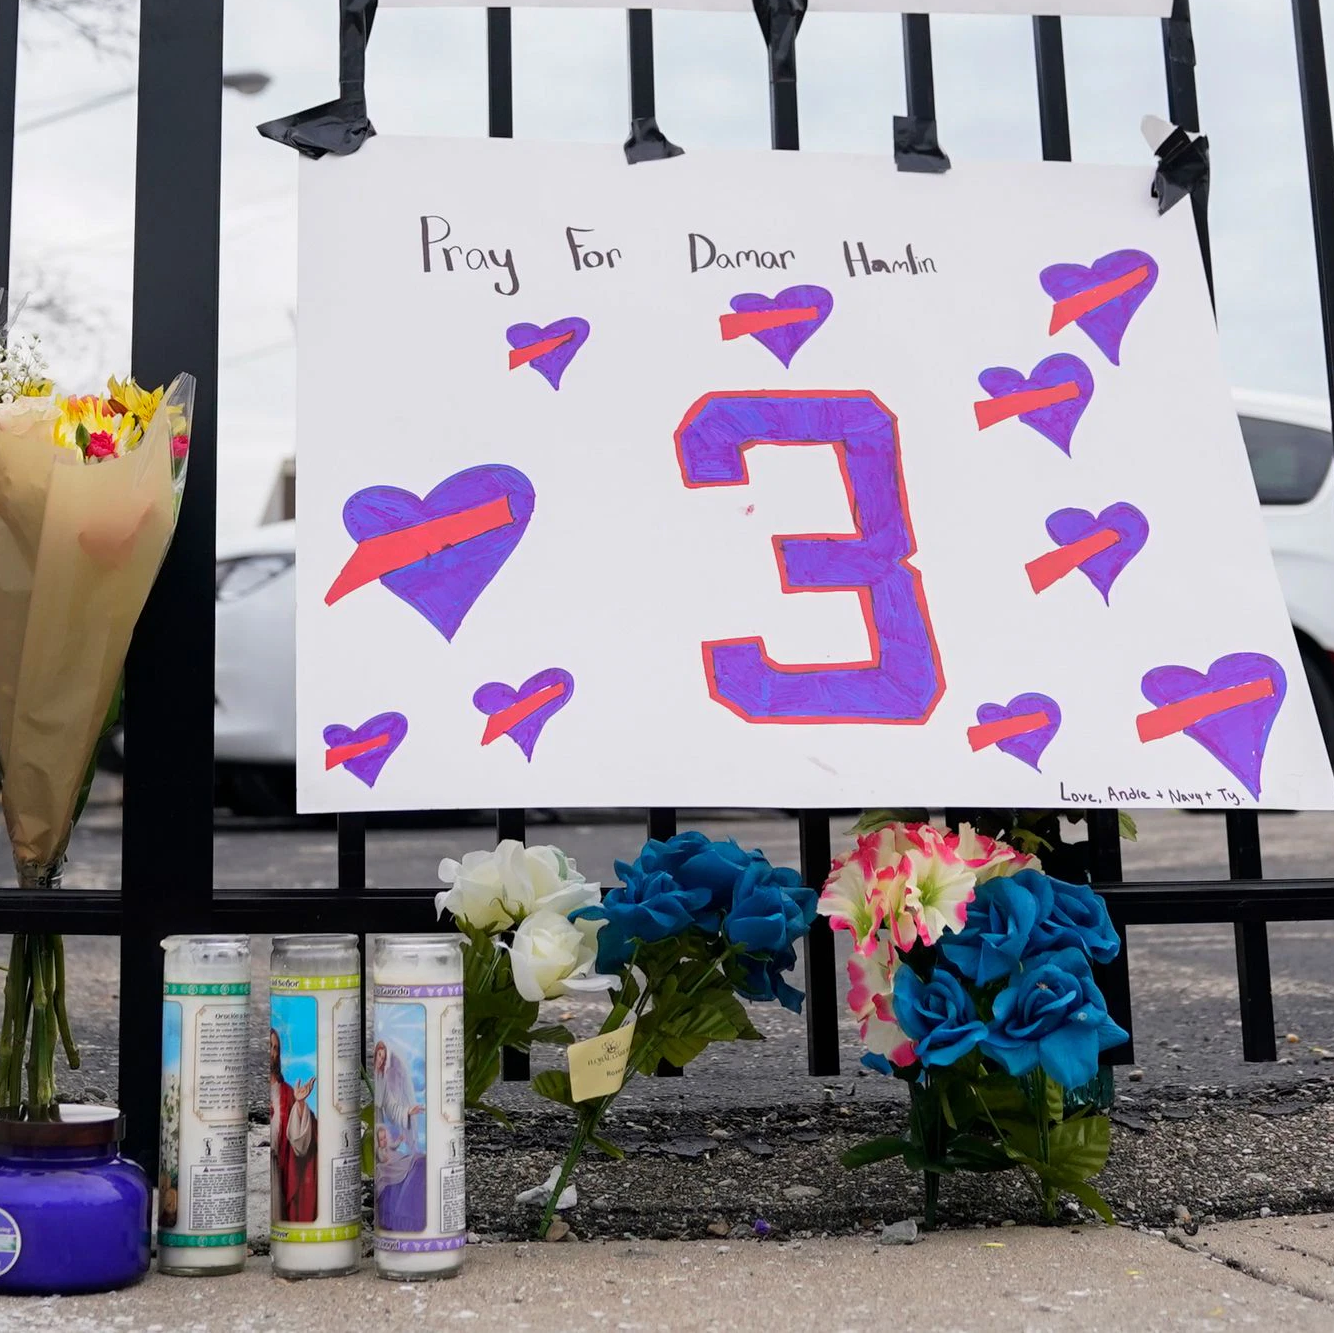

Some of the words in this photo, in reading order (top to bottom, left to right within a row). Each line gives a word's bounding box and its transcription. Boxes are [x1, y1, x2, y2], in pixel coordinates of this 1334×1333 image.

[419, 214, 521, 297] Pray
[565, 225, 623, 272] For
[687, 232, 797, 274] Damar
[842, 239, 939, 279] Hamlin
[671, 388, 948, 726] 3
[1059, 781, 1102, 805] Love,
